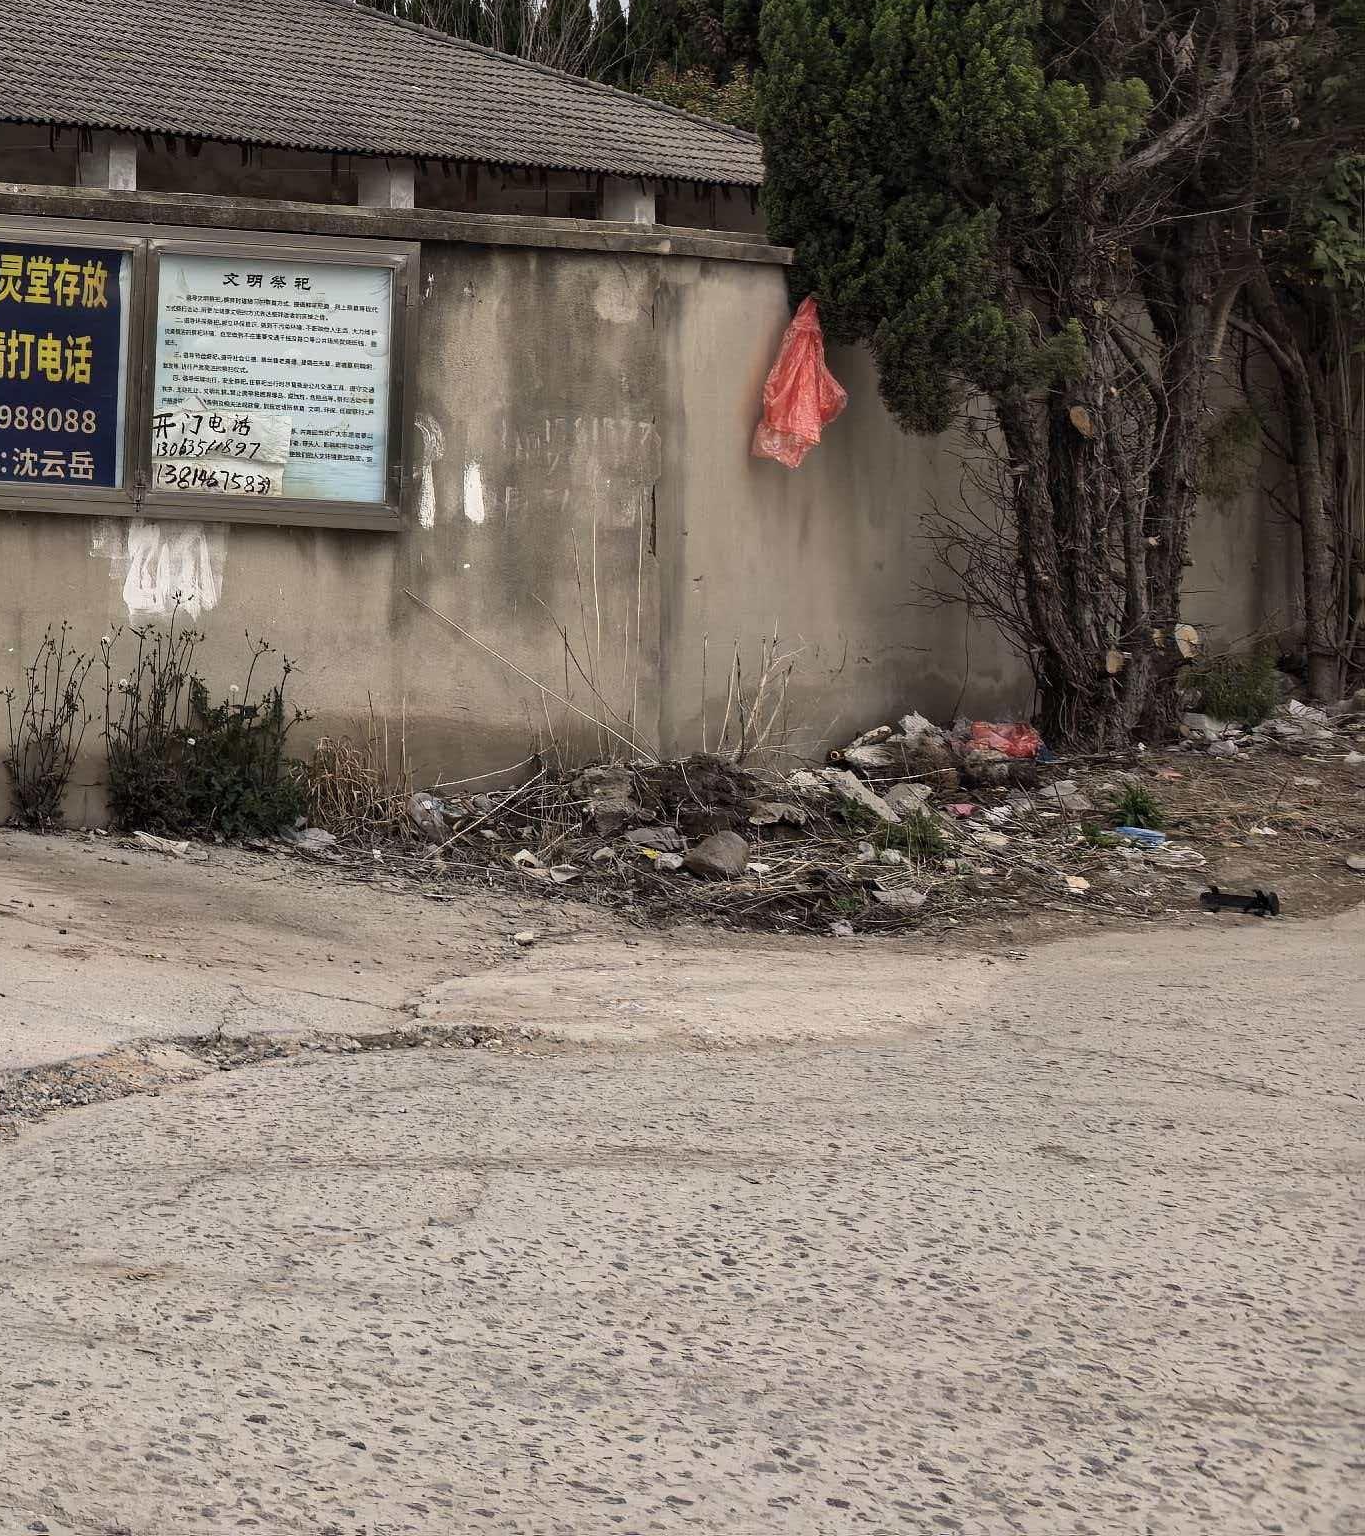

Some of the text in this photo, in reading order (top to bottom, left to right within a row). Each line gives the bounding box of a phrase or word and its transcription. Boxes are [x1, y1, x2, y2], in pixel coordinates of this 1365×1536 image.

[223, 272, 312, 291] 文明祭祀
[153, 413, 252, 438] 开门电话
